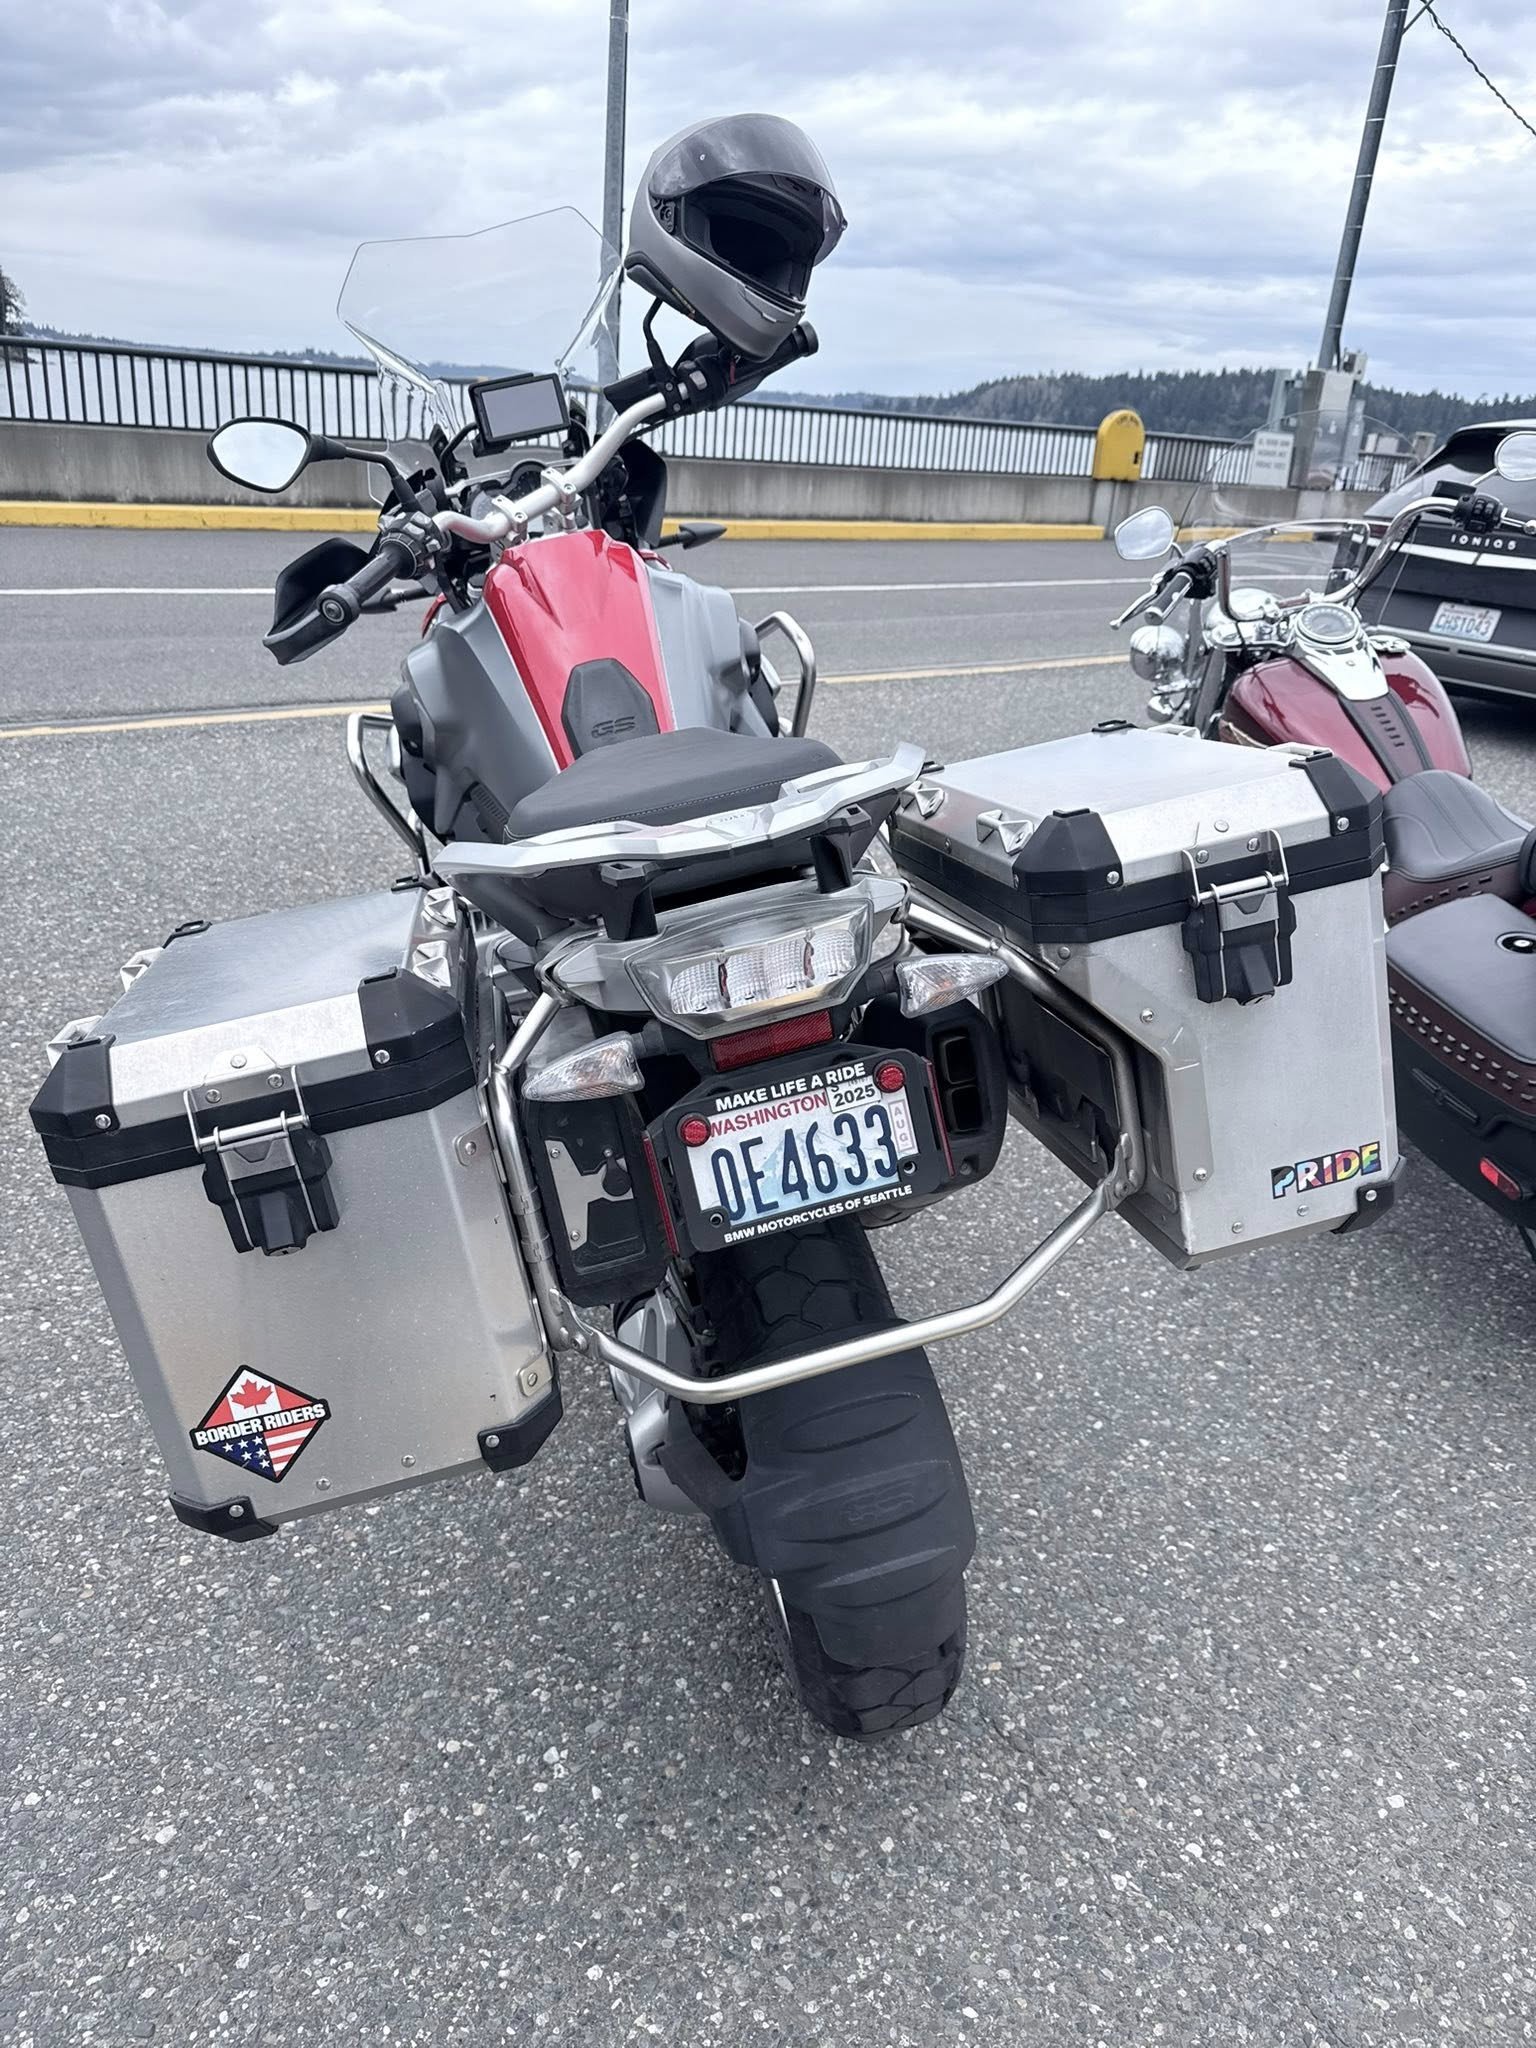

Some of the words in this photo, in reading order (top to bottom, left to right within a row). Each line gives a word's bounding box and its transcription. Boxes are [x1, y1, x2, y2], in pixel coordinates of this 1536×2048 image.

[591, 716, 636, 739] GS
[715, 1087, 768, 1112] MAKE
[770, 1078, 807, 1098] LIFE
[811, 1074, 824, 1089] A
[825, 1062, 866, 1085] RIDE
[833, 1084, 876, 1107] 2025
[710, 1092, 828, 1138] WASHINGTON
[894, 1106, 909, 1142] AUG
[1271, 1141, 1382, 1199] PRIDE
[723, 1227, 756, 1243] BMW
[757, 1202, 844, 1235] MOTORCYCLES
[845, 1199, 861, 1211] OF
[863, 1185, 913, 1206] SEATTLE
[195, 1418, 264, 1446] BORDER
[264, 1403, 326, 1430] RIDERS
